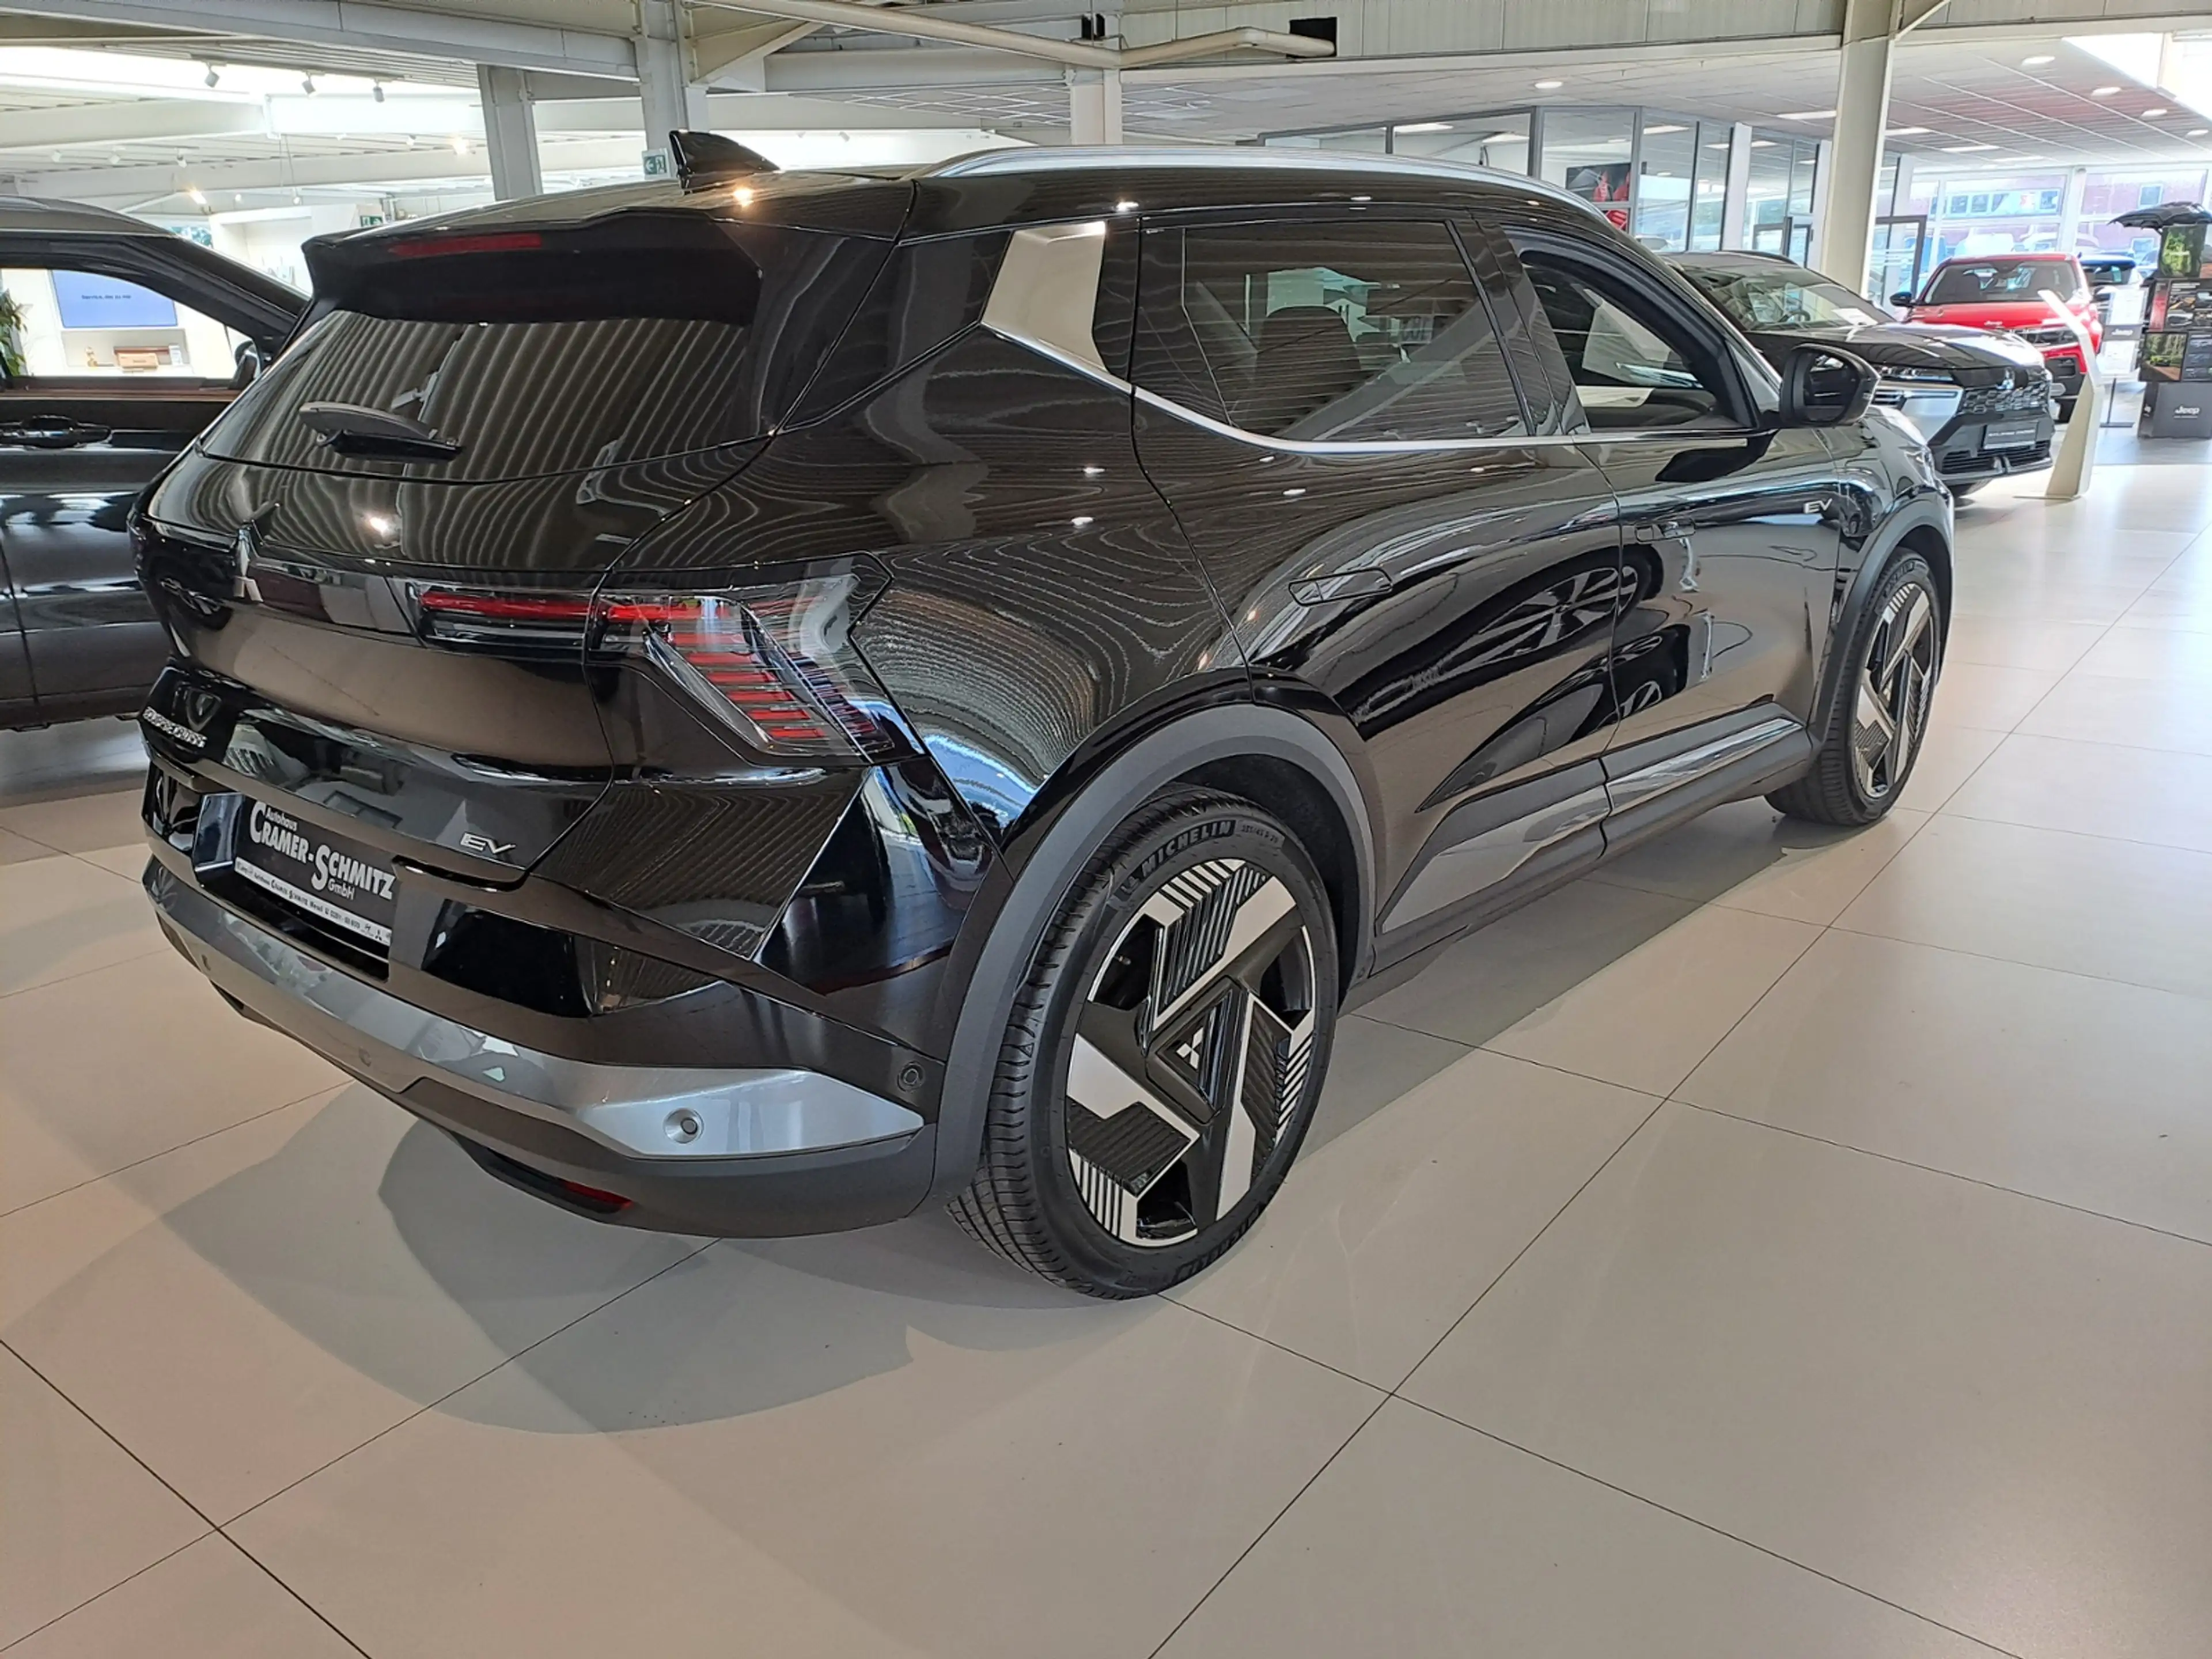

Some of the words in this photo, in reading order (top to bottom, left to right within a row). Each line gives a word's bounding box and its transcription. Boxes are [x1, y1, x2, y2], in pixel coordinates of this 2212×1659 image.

[2174, 405, 2200, 414] Jeep
[1804, 498, 1833, 514] EV
[266, 807, 298, 832] Autohaus
[249, 800, 396, 900] CRAMER-SCHMITZ
[460, 832, 516, 854] EV
[1141, 820, 1232, 877] MICHELIN
[327, 877, 355, 900] GmbH
